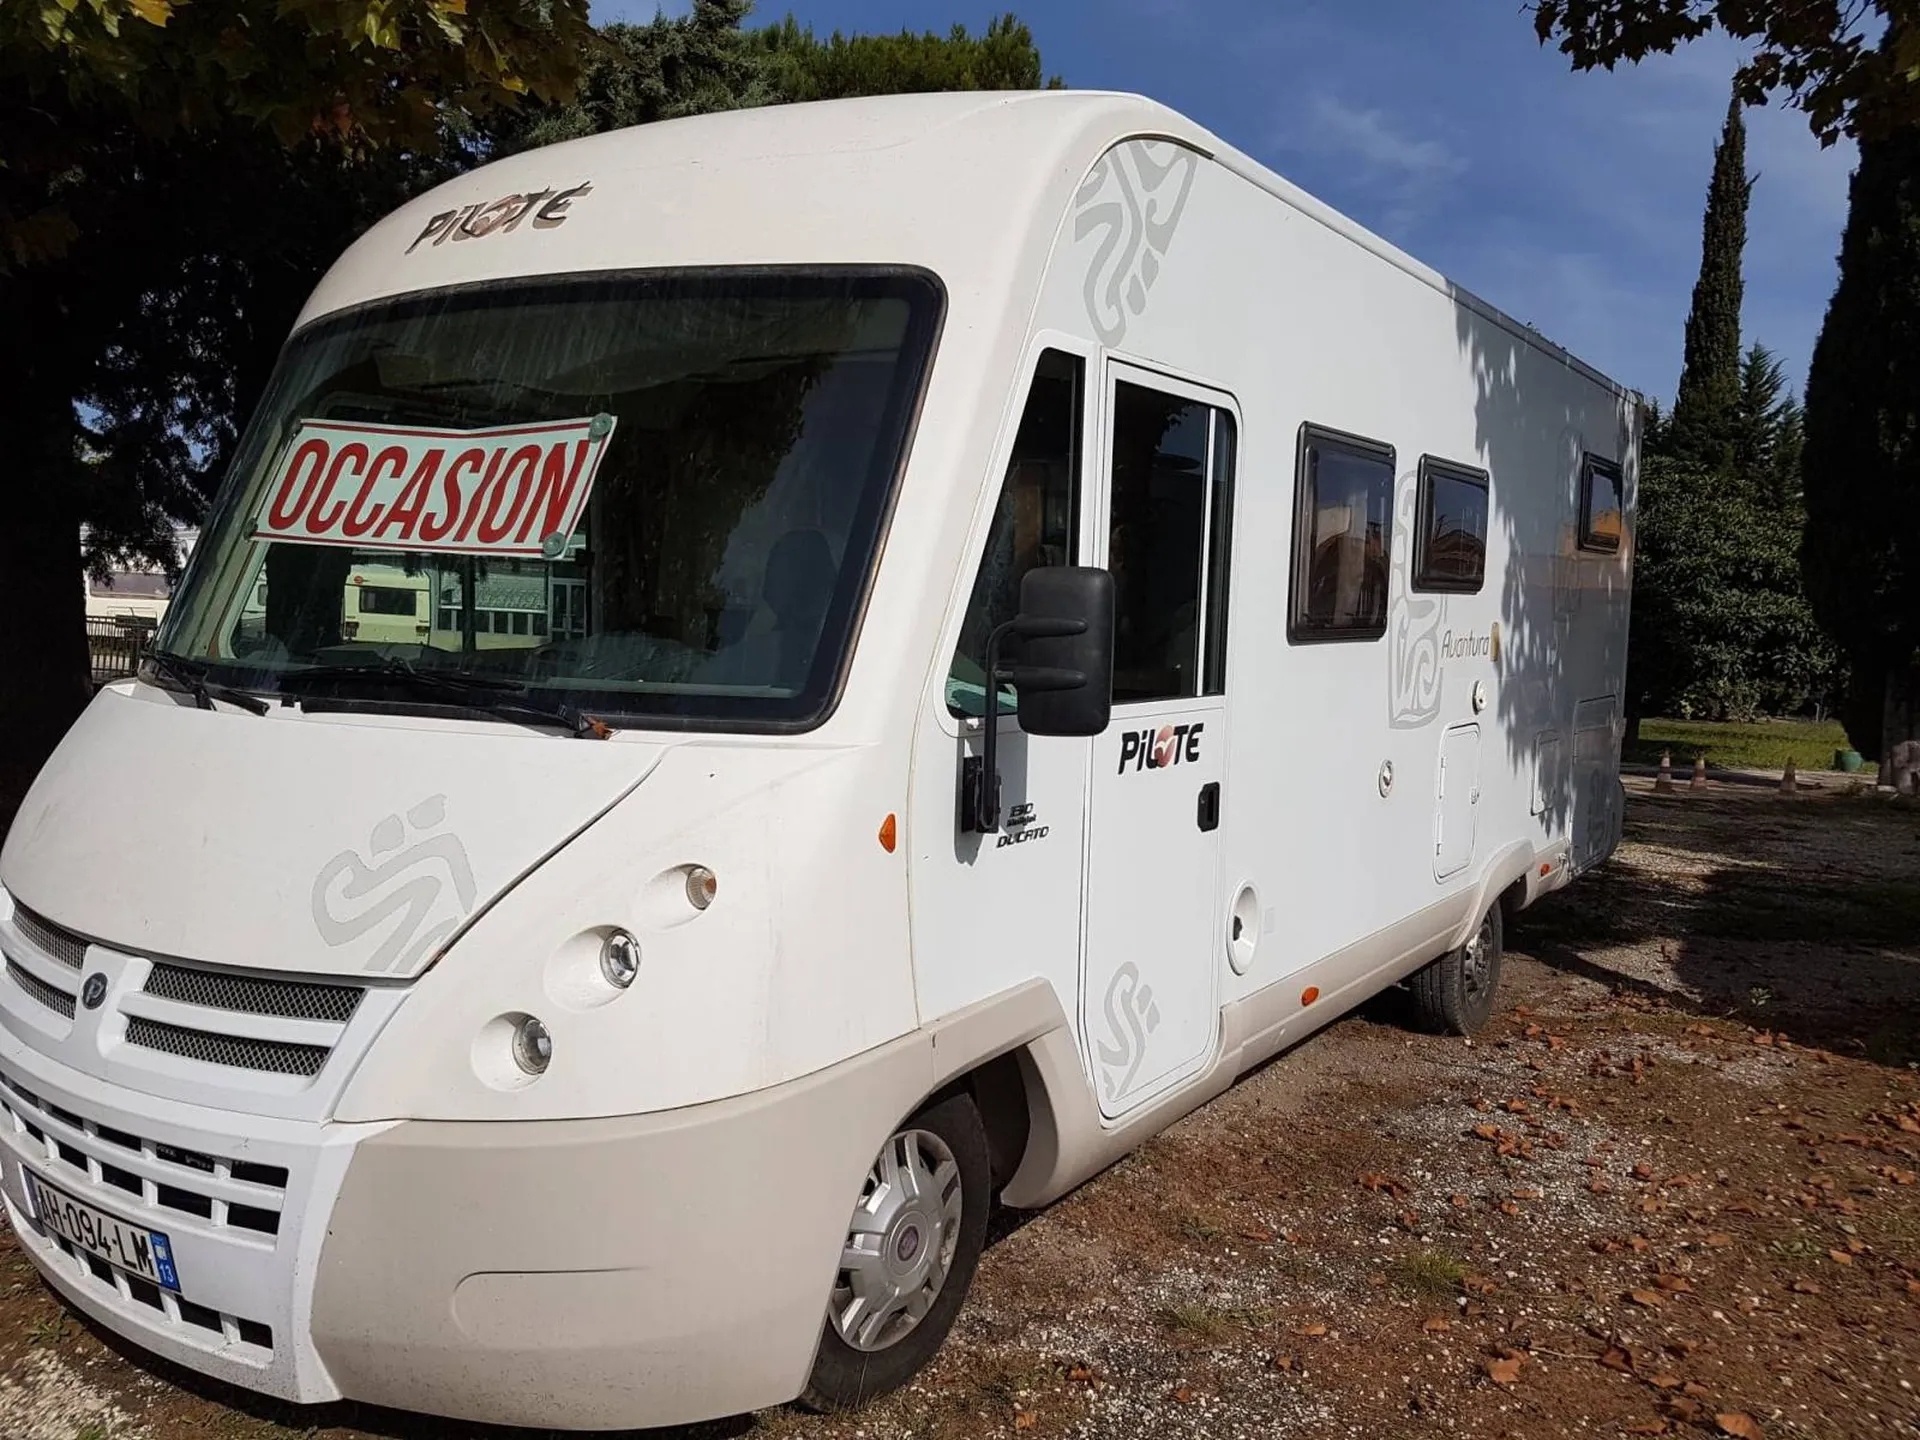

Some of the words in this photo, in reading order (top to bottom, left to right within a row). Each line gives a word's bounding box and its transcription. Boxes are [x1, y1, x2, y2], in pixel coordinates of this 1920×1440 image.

[268, 438, 590, 544] OCCASION
[996, 826, 1049, 849] DUCATO
[158, 1263, 175, 1283] 13
